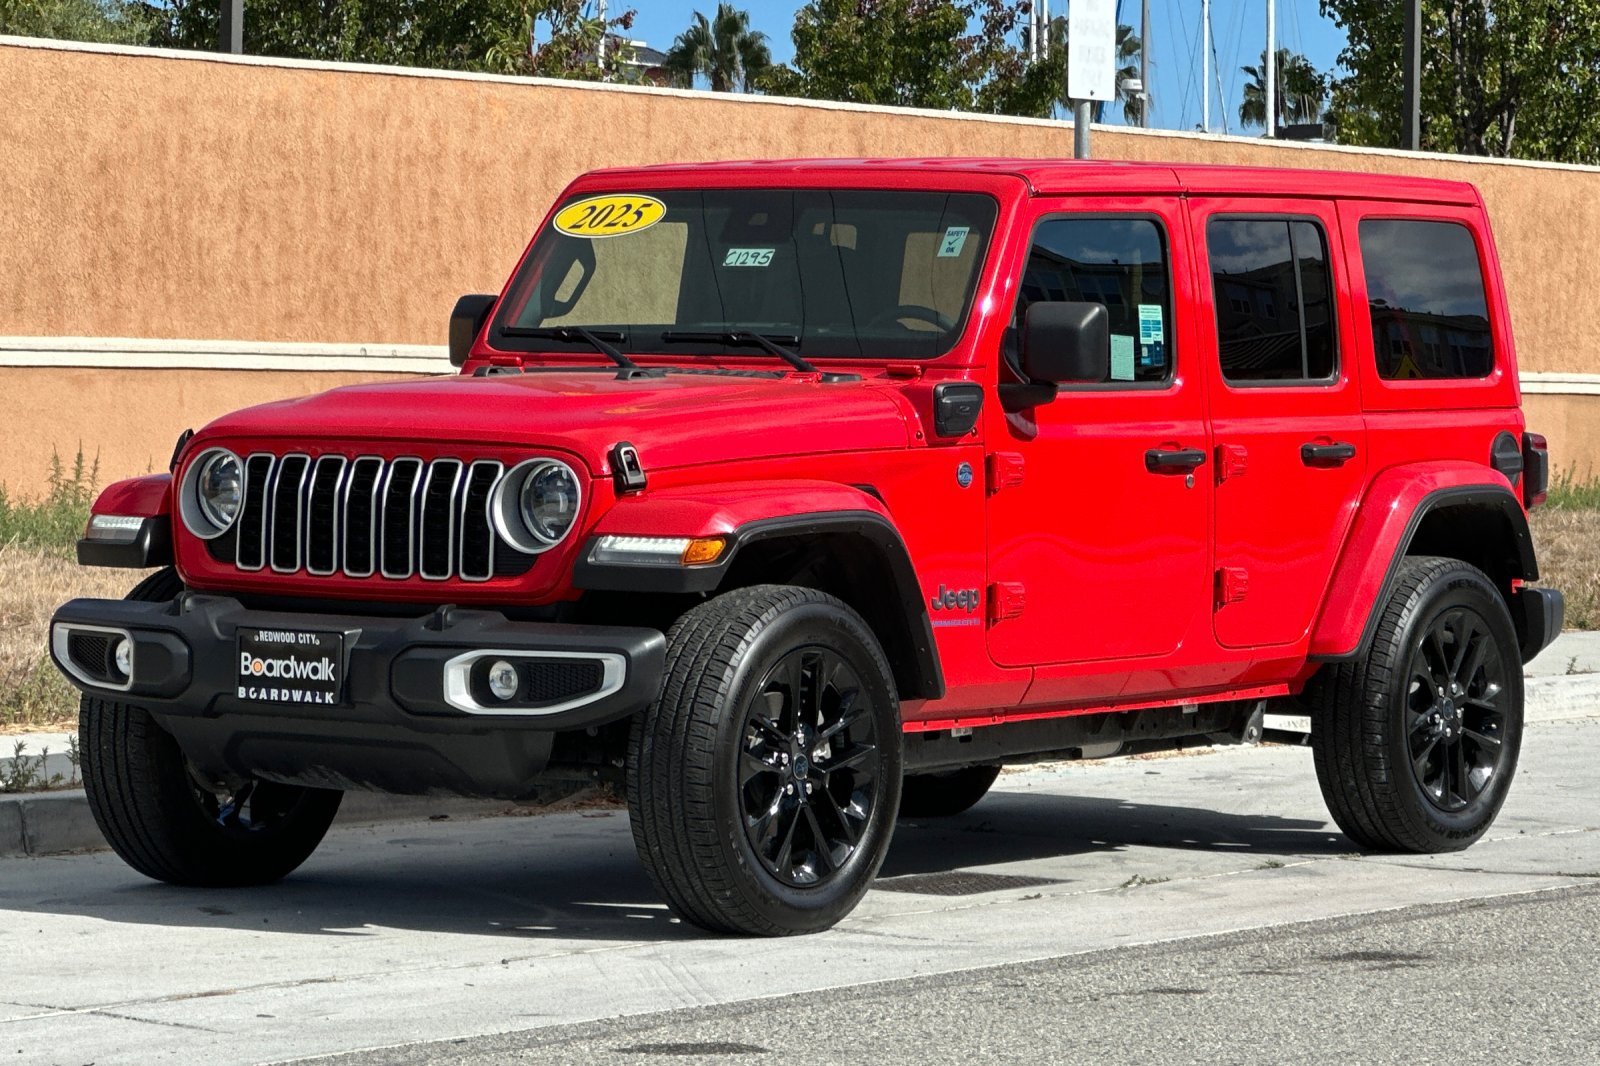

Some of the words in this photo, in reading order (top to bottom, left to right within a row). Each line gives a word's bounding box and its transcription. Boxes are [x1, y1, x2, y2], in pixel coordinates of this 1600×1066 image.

[568, 203, 653, 229] 2025
[725, 250, 773, 266] C1295
[932, 584, 979, 613] Jeep
[259, 631, 296, 643] REDWOOD
[298, 633, 316, 645] CITY
[241, 652, 335, 681] Boardwalk
[238, 686, 334, 704] BOARDWALK
